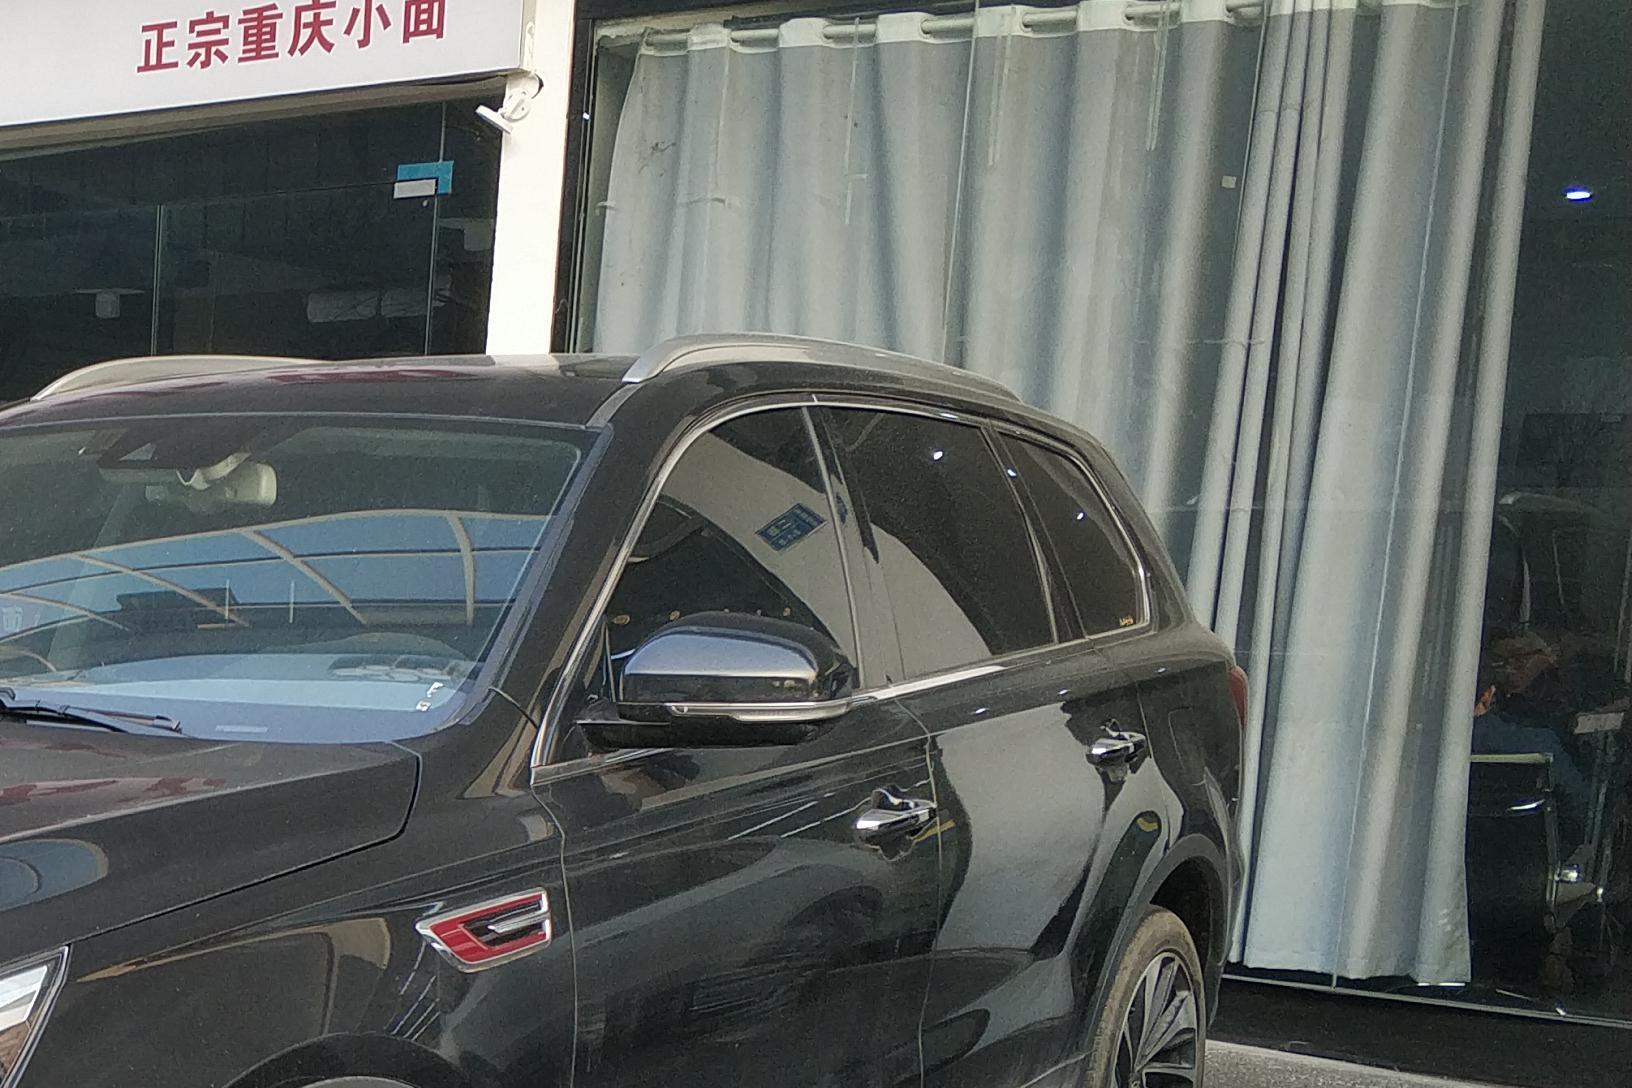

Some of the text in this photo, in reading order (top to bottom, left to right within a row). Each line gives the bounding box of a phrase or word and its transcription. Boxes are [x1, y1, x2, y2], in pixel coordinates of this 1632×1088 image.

[136, 0, 446, 73] 正宗重庆小面
